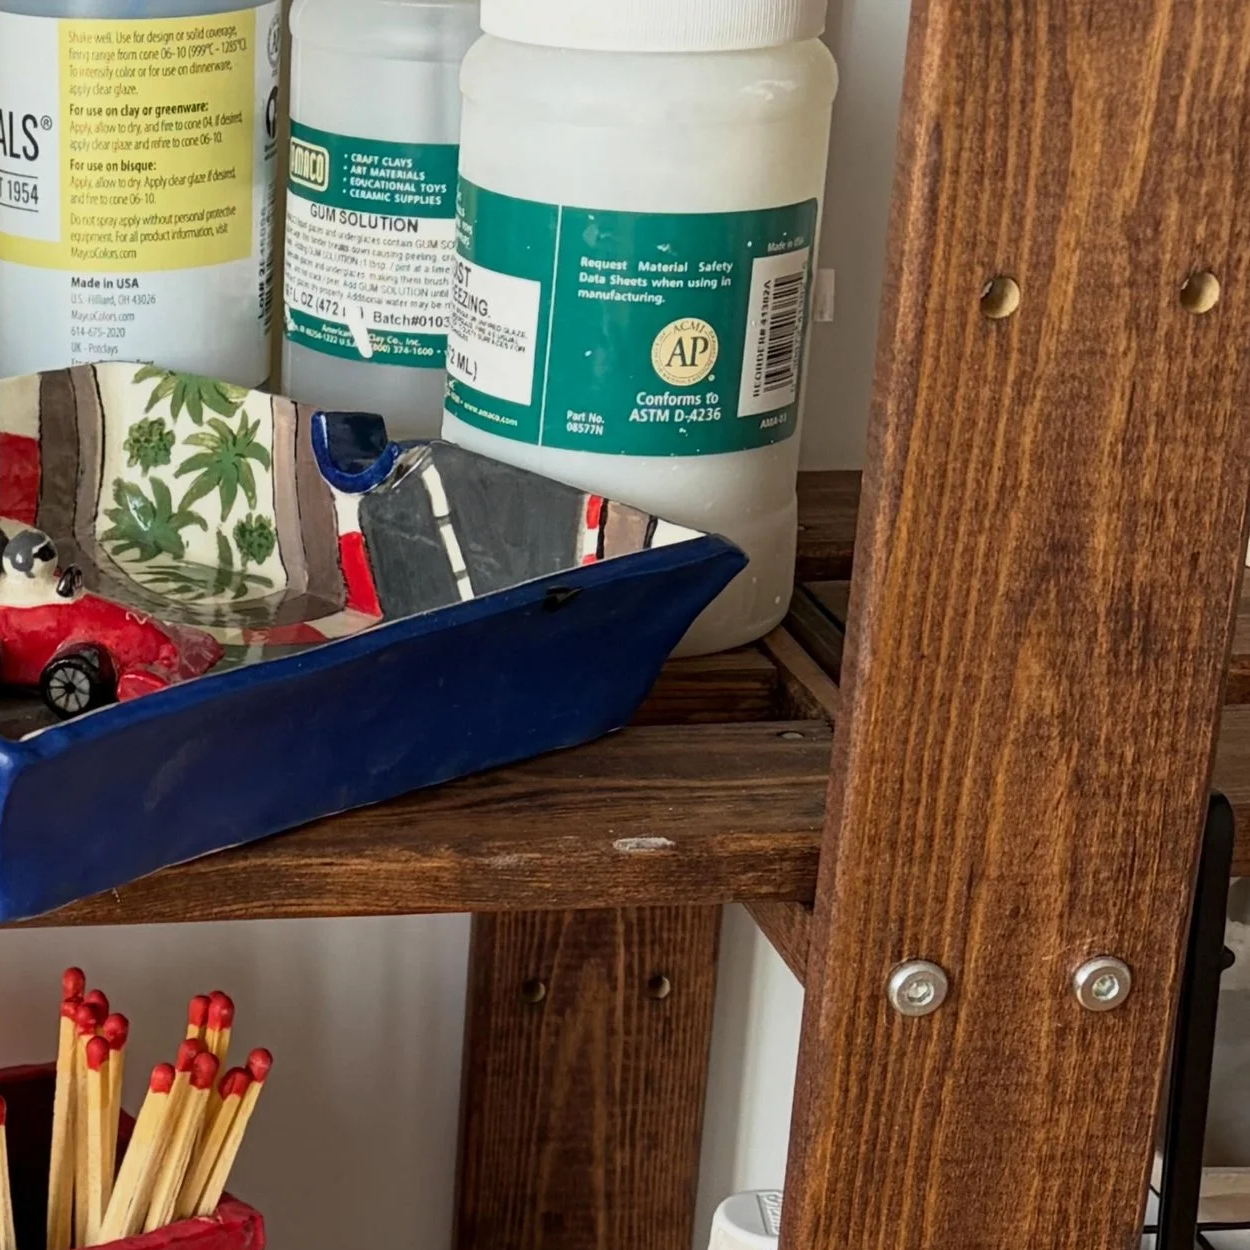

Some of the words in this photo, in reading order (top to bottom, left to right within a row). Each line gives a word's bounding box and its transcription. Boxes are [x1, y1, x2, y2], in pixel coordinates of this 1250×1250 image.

[116, 32, 131, 43] Use
[133, 31, 145, 43] for
[147, 30, 174, 45] design
[175, 31, 184, 41] or
[186, 28, 204, 40] solid
[116, 65, 136, 77] color
[138, 66, 147, 76] or
[149, 65, 160, 76] for
[161, 65, 176, 75] use
[69, 103, 84, 116] For
[86, 104, 103, 116] use
[105, 105, 118, 117] on
[120, 103, 141, 119] clay
[143, 104, 153, 115] or
[155, 101, 209, 119] greenware:
[69, 159, 84, 172] For
[86, 161, 103, 172] use
[105, 160, 118, 172] on
[120, 158, 157, 174] bisque:
[382, 156, 413, 169] CLAYS
[350, 164, 367, 175] ART
[370, 167, 425, 181] MATERIALS
[7, 180, 39, 205] 1954
[349, 176, 417, 193] EDUCATIONAL
[420, 183, 447, 194] TOYS
[349, 188, 391, 202] CERAMIC
[394, 193, 442, 206] SUPPLIES
[310, 203, 336, 223] GUM
[339, 210, 419, 233] SOLUTION
[580, 256, 627, 272] Request
[638, 260, 688, 273] Material
[698, 261, 733, 274] Safety
[70, 276, 100, 289] Made
[103, 277, 114, 289] in
[117, 278, 139, 290] USA
[578, 272, 606, 285] Data
[609, 275, 648, 288] Sheets
[651, 277, 683, 289] when
[687, 276, 718, 290] using
[720, 275, 732, 287] in
[578, 289, 666, 306] manufacturing.
[315, 297, 339, 316] (472
[672, 320, 706, 334] ACMI
[665, 336, 710, 368] AP
[636, 391, 696, 407] Conforms
[704, 391, 719, 405] to
[566, 409, 587, 422] Part
[588, 412, 605, 424] No.
[628, 408, 669, 423] ASTM
[674, 408, 721, 424] D-4236
[566, 421, 604, 436] 08577N
